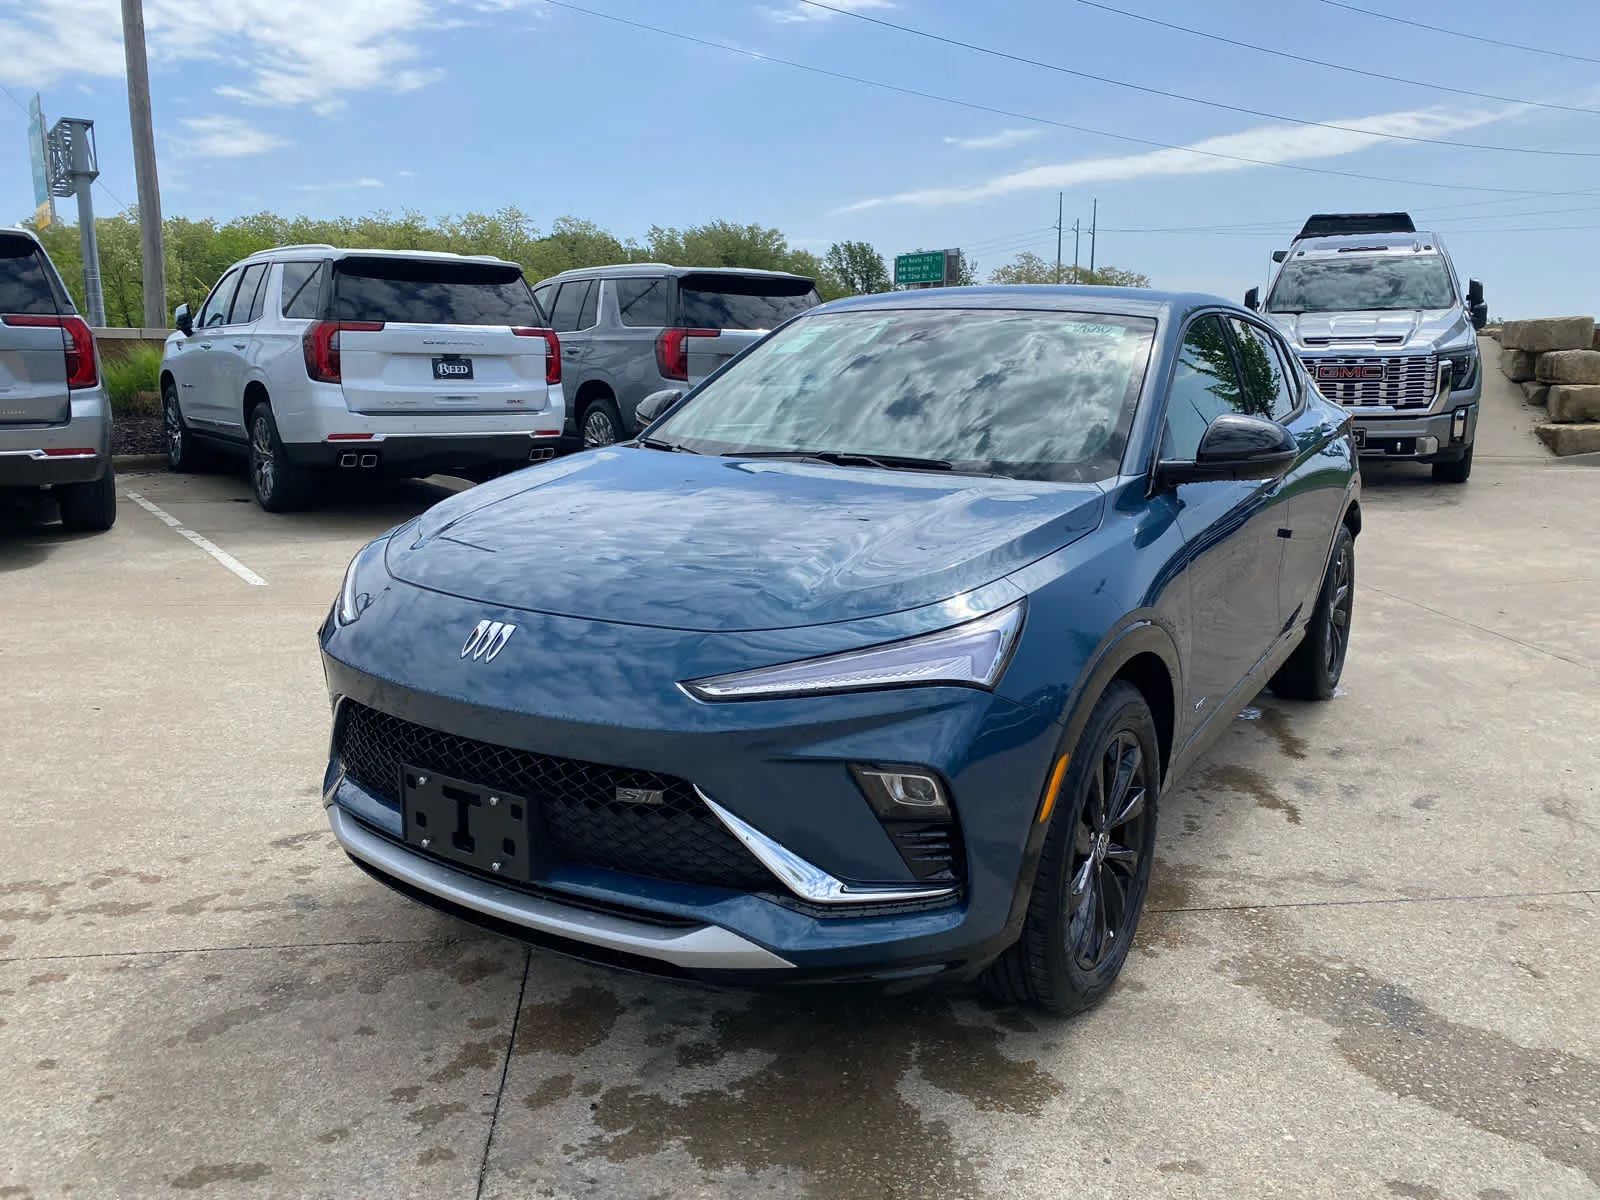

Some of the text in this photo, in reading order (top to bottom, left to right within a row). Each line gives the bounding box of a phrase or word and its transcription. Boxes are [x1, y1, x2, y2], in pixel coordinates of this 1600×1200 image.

[437, 363, 468, 376] REED
[1320, 366, 1382, 378] GMC
[616, 787, 664, 805] ST
